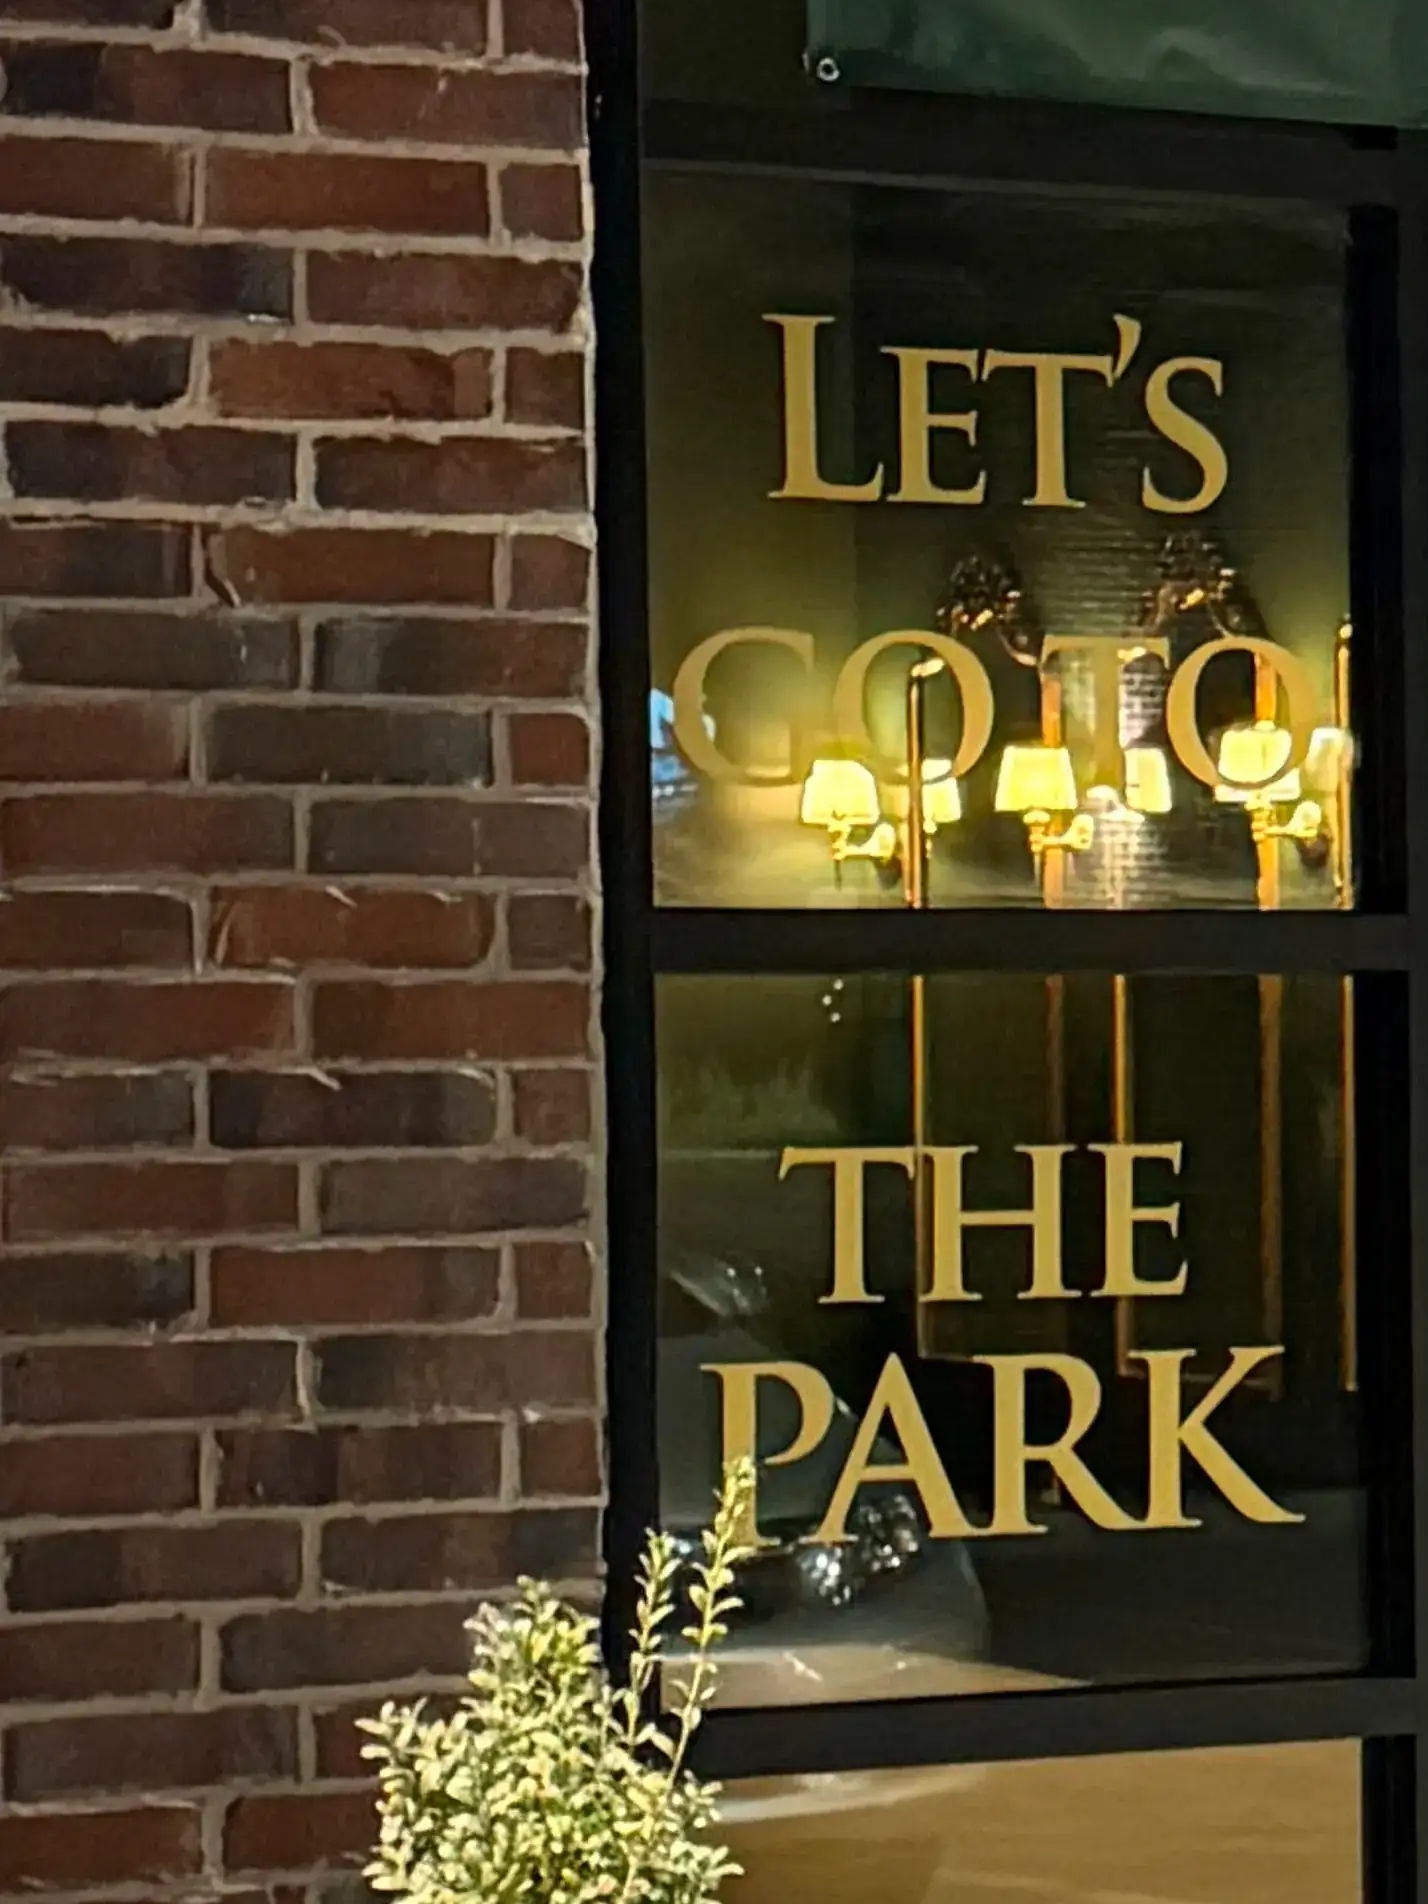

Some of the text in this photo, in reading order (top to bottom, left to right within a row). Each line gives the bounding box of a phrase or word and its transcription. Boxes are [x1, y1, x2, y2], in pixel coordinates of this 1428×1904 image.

[762, 313, 1228, 513] LET'S
[670, 626, 1320, 790] GO TO
[778, 1141, 1190, 1305] THE
[700, 1344, 1305, 1547] PARK
